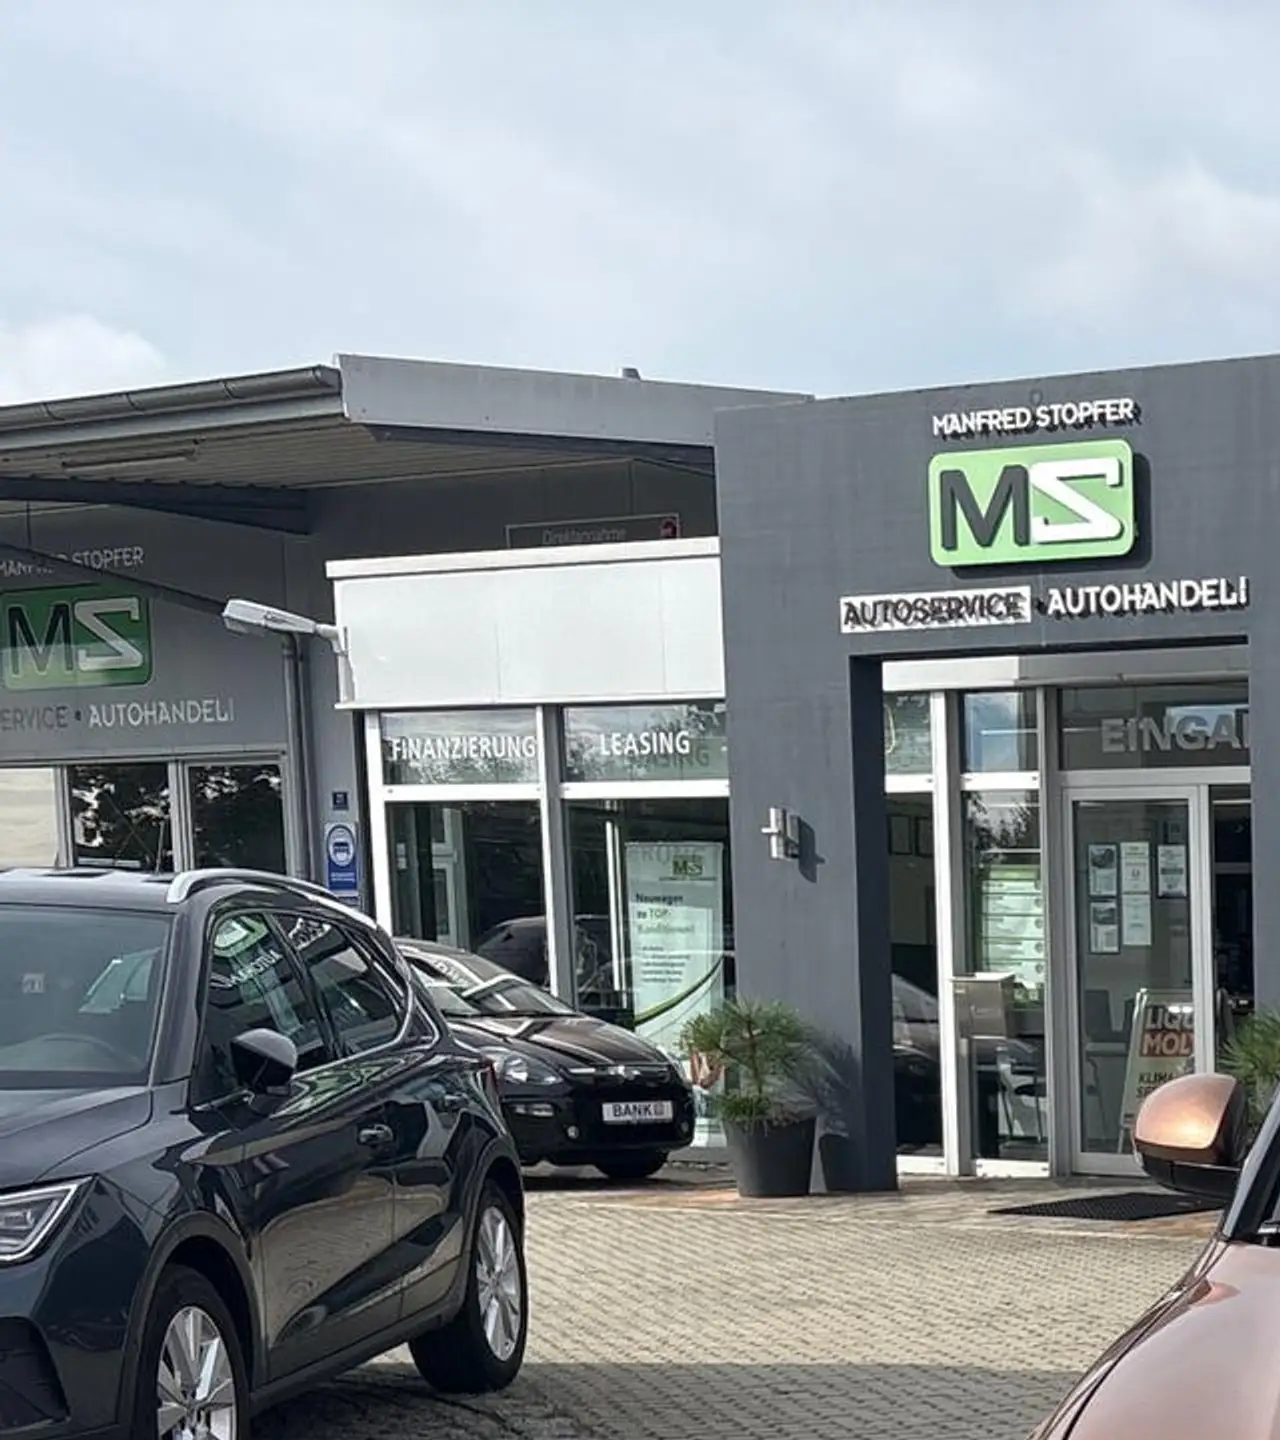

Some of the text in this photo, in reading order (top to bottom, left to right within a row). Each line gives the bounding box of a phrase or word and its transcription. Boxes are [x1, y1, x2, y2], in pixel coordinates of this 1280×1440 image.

[931, 398, 1134, 436] MANFRED STOPFER
[843, 591, 1023, 627] AUTOSERVICE
[391, 735, 537, 761] FINANZIERUNG
[600, 730, 691, 756] LEASING
[612, 1102, 652, 1117] BANK
